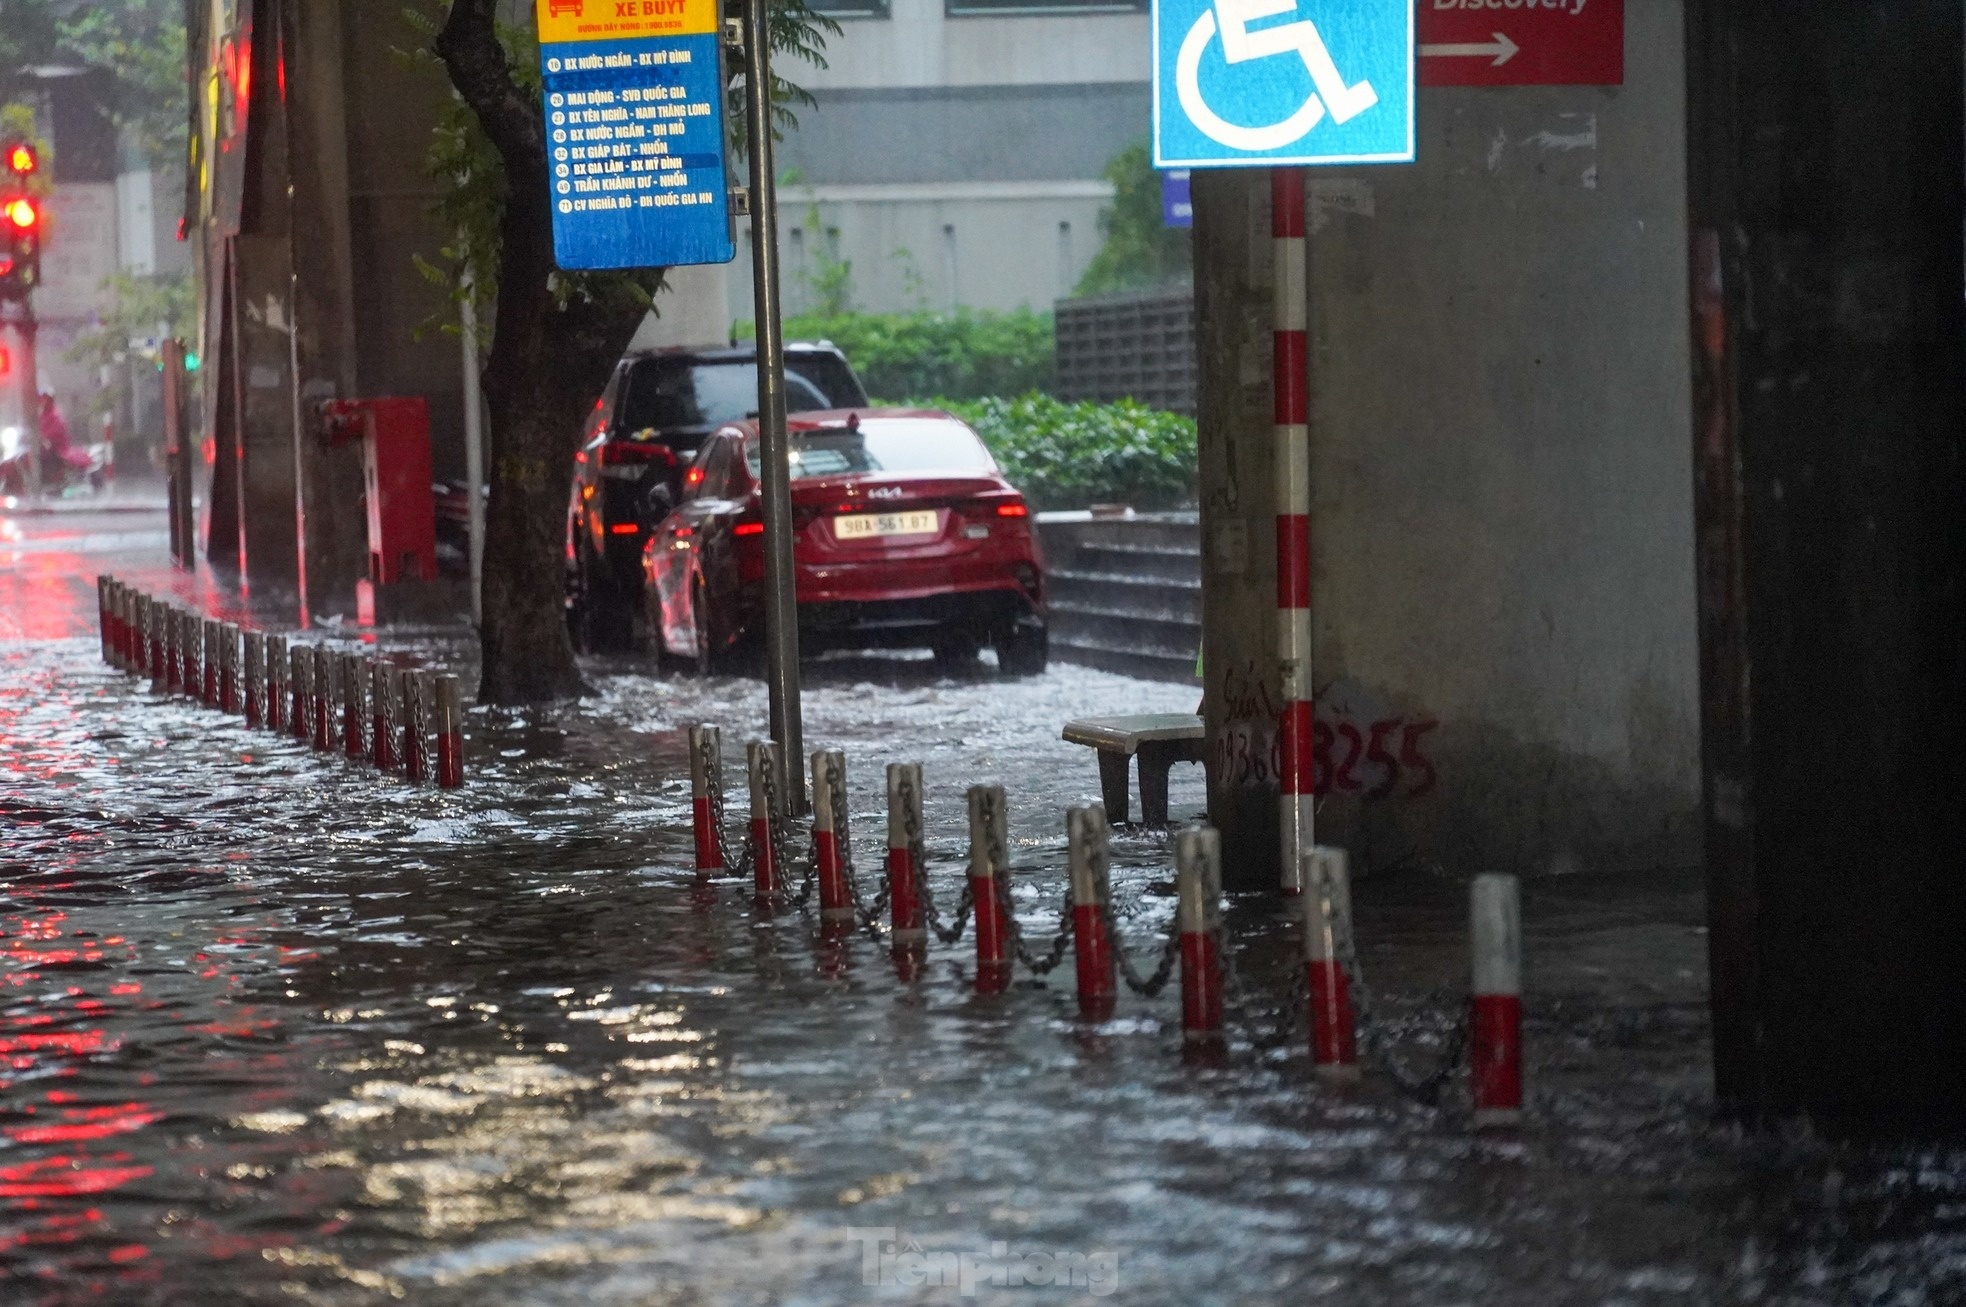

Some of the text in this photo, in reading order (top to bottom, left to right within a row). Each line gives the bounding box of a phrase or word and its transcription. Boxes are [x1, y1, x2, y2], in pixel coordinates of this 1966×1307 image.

[616, 2, 637, 17] XE
[565, 58, 577, 70] BX
[579, 54, 603, 69] NƯỚC
[639, 53, 652, 65] BX
[653, 50, 667, 64] MỸ
[669, 49, 691, 63] ĐÌNH
[568, 93, 586, 105] MAI
[588, 90, 614, 106] ĐỘNG
[642, 84, 668, 102] QUỐC
[670, 86, 686, 99] GIA
[569, 112, 581, 123] BX
[583, 108, 600, 122] YÊN
[602, 107, 628, 121] NGHĨA
[635, 107, 656, 119] NAM
[658, 104, 686, 117] THĂNG
[688, 103, 710, 116] LONG
[570, 129, 584, 141] BX
[586, 125, 613, 140] NƯỚC
[653, 124, 666, 136] ĐH
[669, 118, 685, 135] MỎ
[572, 147, 585, 159] BX
[588, 144, 610, 158] GIÁP
[612, 142, 631, 156] BÁT
[640, 138, 668, 155] NHỔN
[574, 164, 587, 175] BX
[588, 163, 603, 174] GIA
[604, 160, 624, 173] LÂM
[631, 160, 643, 171] BX
[645, 156, 658, 170] MỸ
[661, 156, 682, 169] ĐÌNH
[574, 176, 600, 192] TRẦN
[602, 174, 635, 190] KHÁNH
[637, 176, 652, 188] DƯ
[660, 170, 687, 186] NHỔN
[574, 200, 586, 211] CV
[588, 196, 617, 210] NGHĨA
[619, 195, 631, 208] ĐÔ
[640, 196, 653, 207] ĐH
[655, 191, 679, 207] QUỐC
[681, 194, 697, 204] GIA
[699, 192, 712, 204] HN
